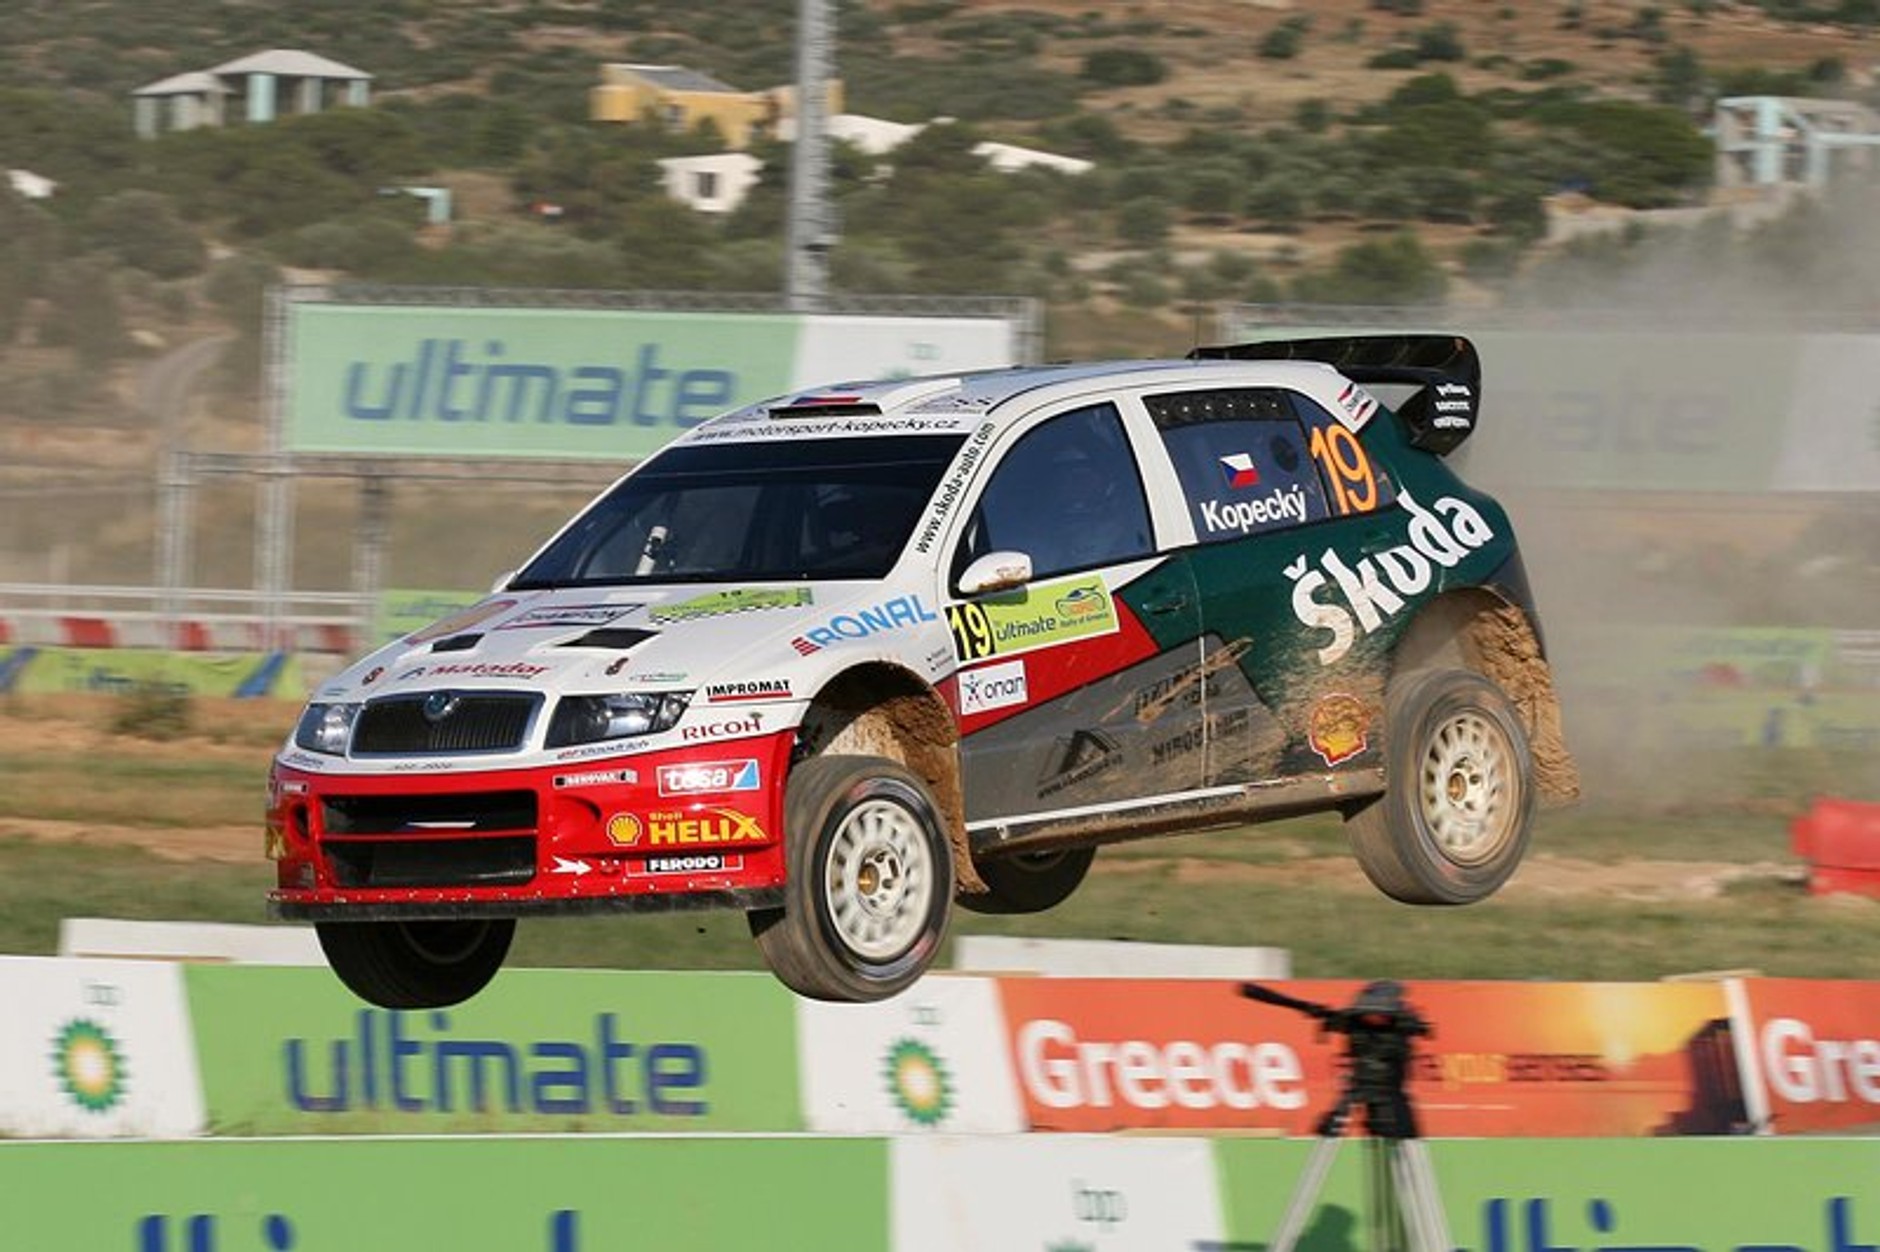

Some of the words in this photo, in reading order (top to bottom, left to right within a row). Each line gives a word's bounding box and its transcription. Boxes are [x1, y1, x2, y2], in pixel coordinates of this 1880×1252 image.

[342, 338, 737, 427] ultimate
[915, 422, 996, 554] www.skoda-auto.com
[1310, 423, 1379, 515] 19
[1200, 484, 1306, 533] Kopecký
[1283, 487, 1495, 667] Škoda
[806, 594, 938, 647] RONAL
[950, 602, 993, 661] 19
[996, 615, 1057, 642] ultimate
[429, 662, 552, 677] Matador
[706, 679, 791, 697] IMPROMAT
[682, 718, 763, 741] RICOH
[664, 767, 732, 792] tesa
[648, 811, 683, 821] Shell
[648, 808, 769, 846] HELIX
[650, 856, 720, 871] FERODO
[283, 1009, 708, 1114] ultimate
[1017, 1019, 1308, 1110] Greece
